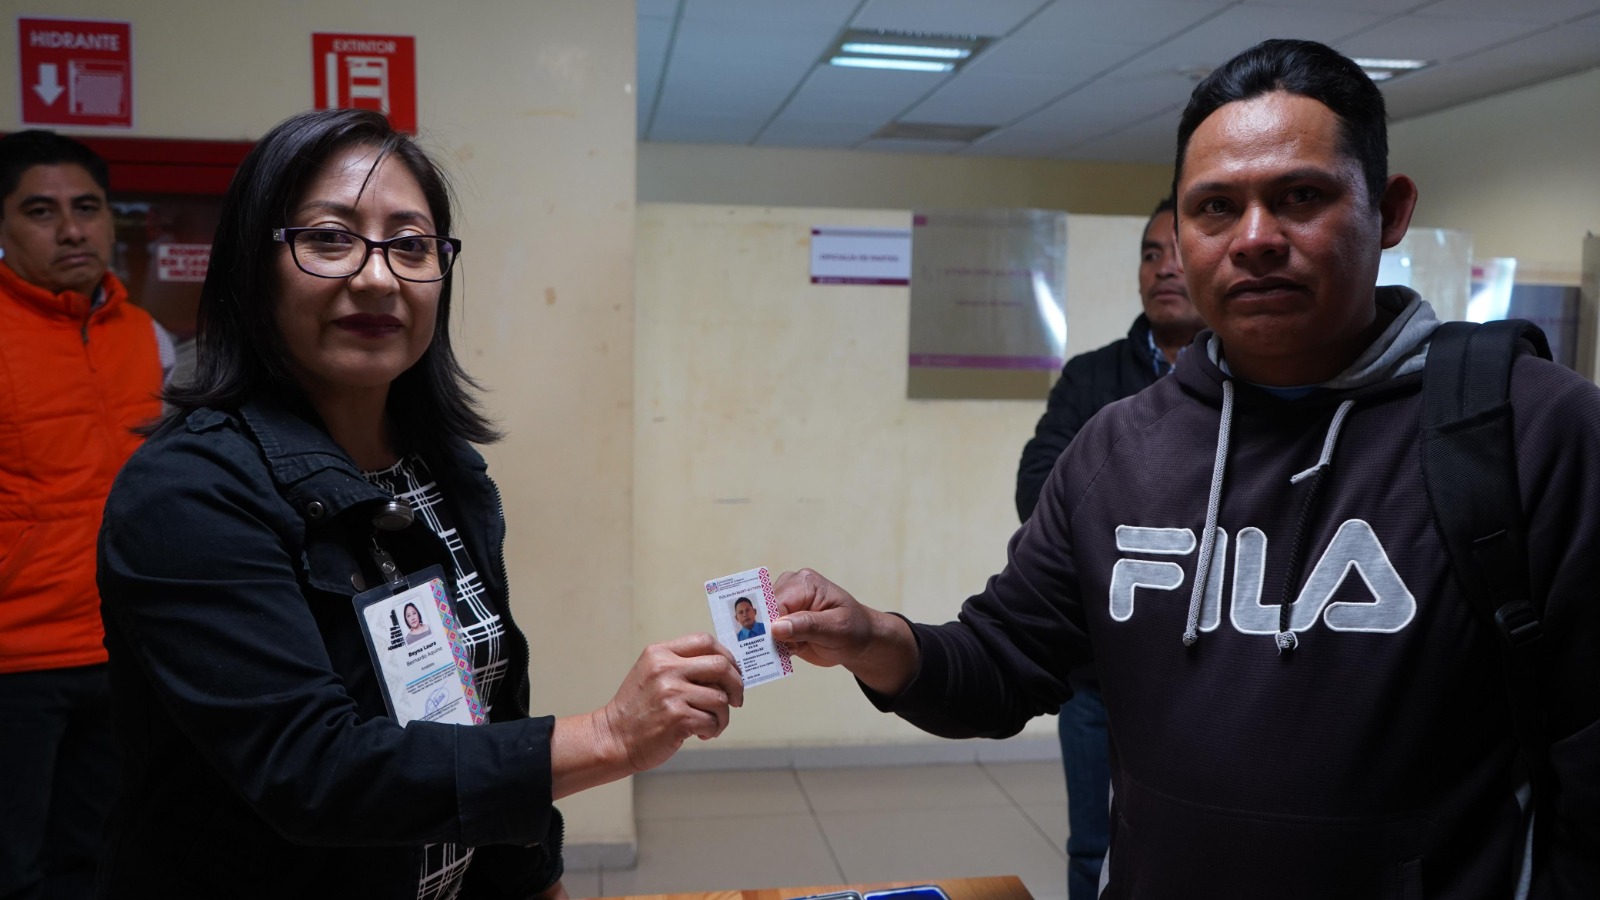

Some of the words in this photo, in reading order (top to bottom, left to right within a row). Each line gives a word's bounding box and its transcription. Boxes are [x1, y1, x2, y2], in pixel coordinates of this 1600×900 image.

[30, 30, 120, 52] HIDRANTE
[332, 39, 397, 54] EXTINTOR
[1108, 517, 1417, 635] FILA
[423, 641, 437, 651] Laura
[406, 654, 428, 667] Bernardo
